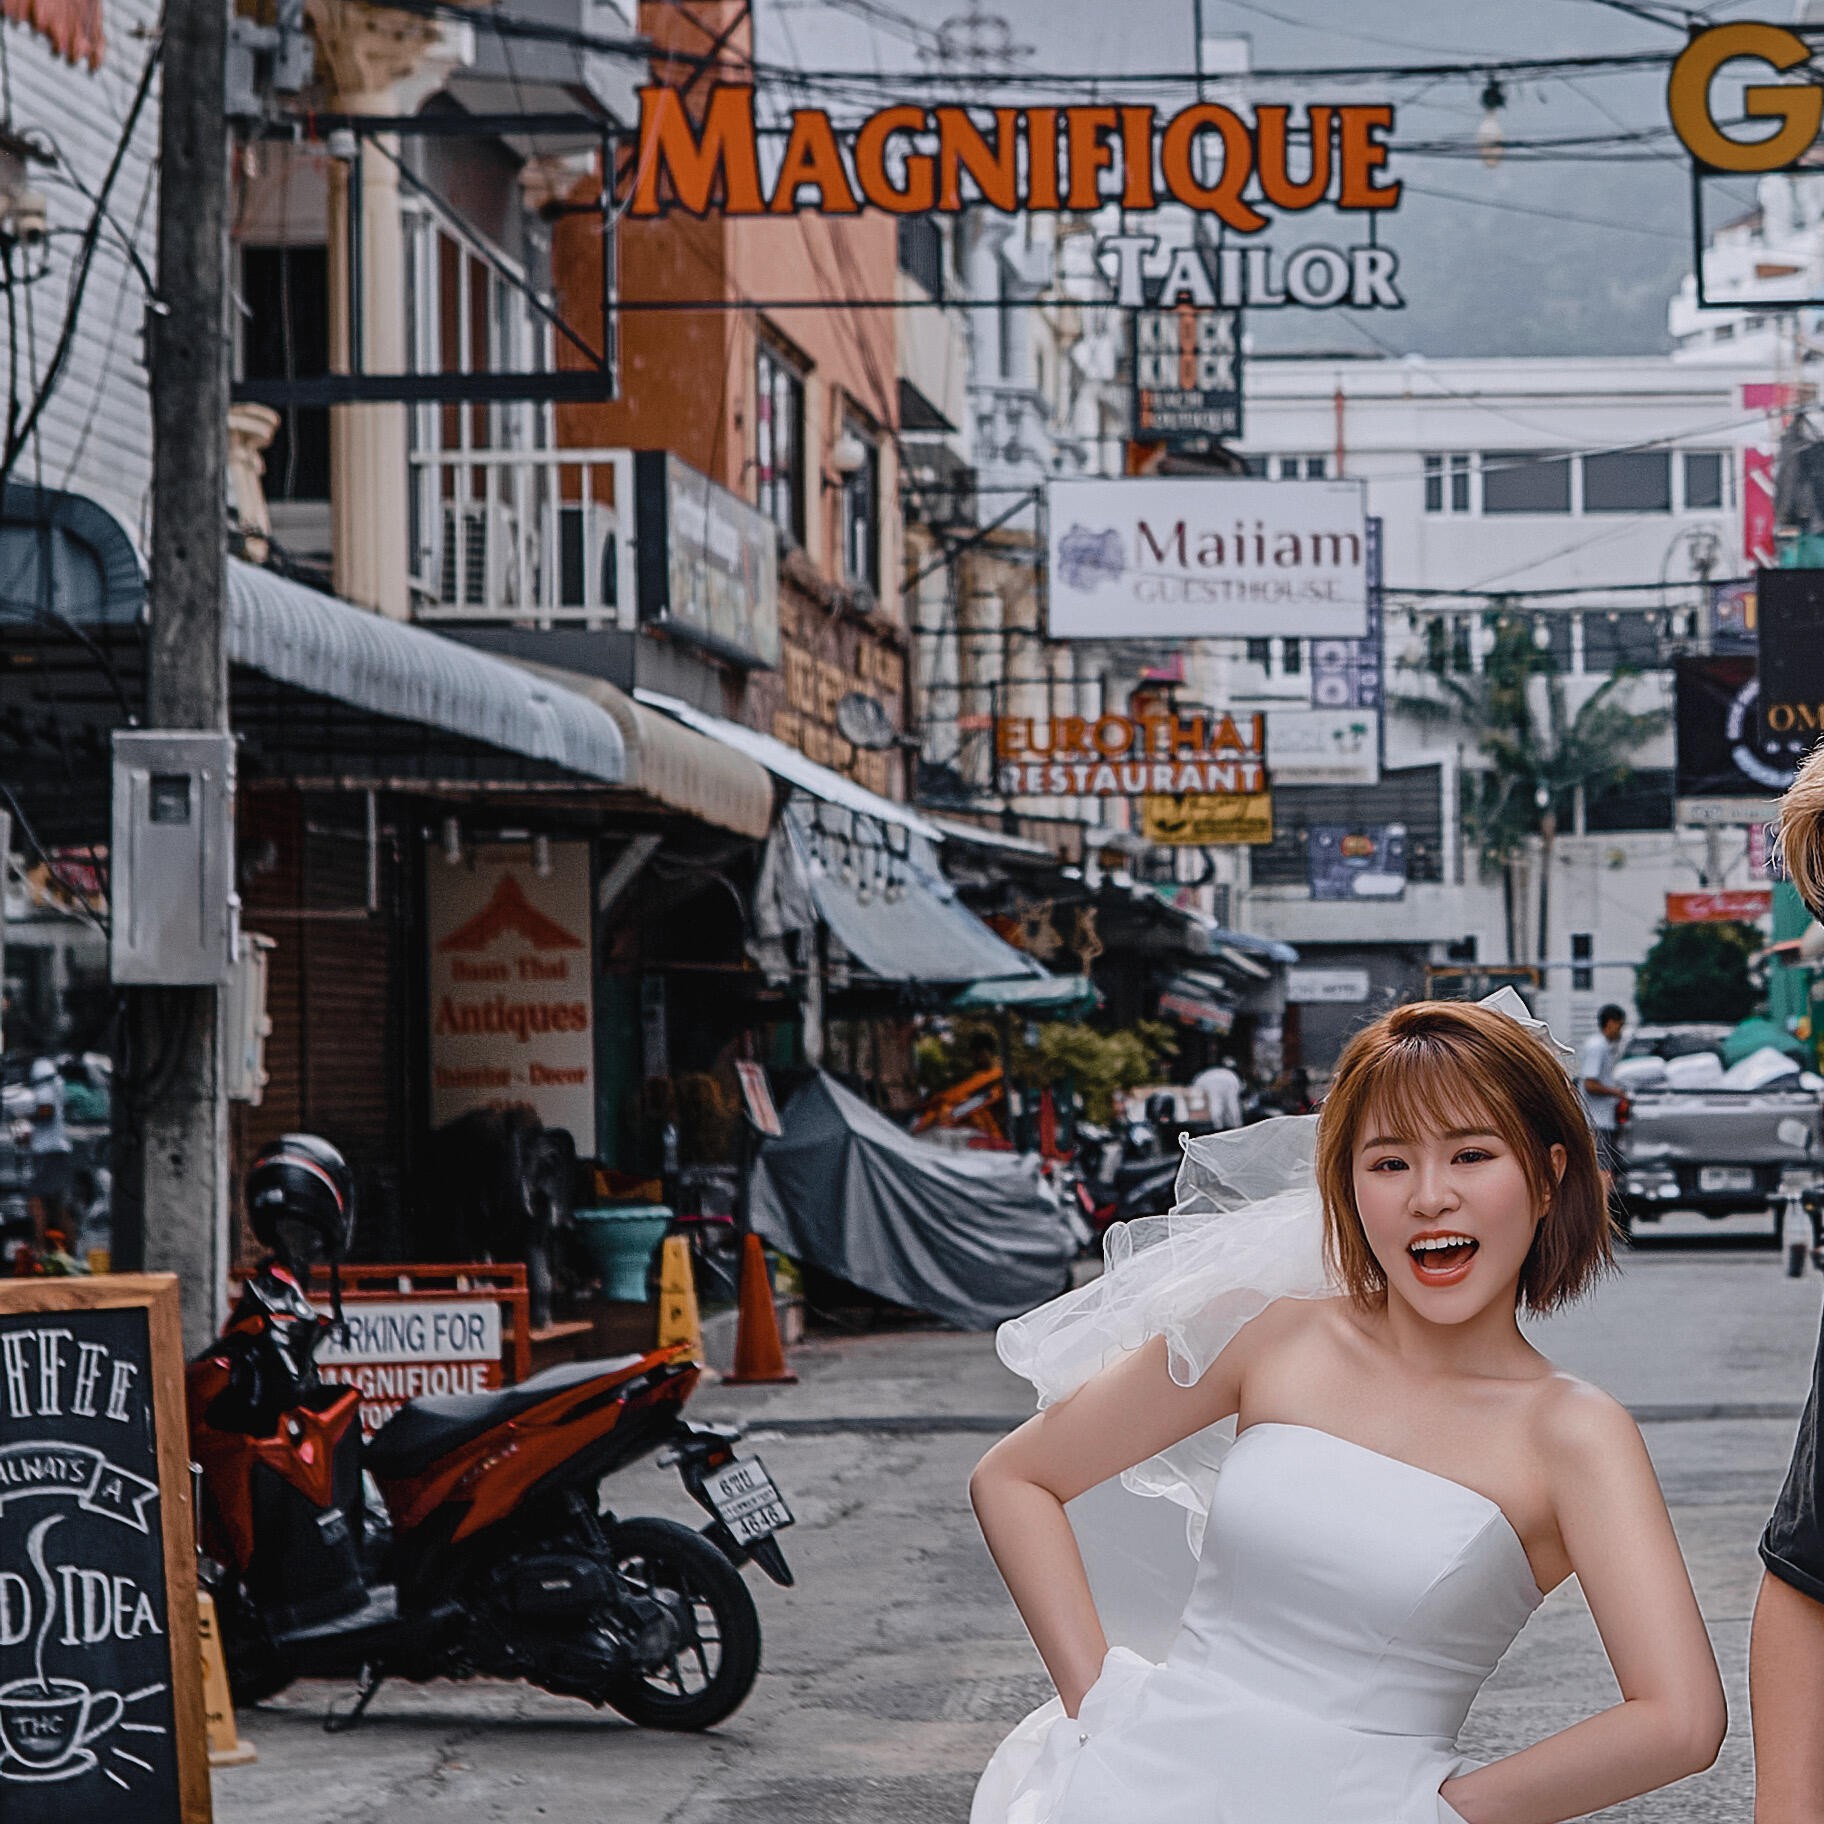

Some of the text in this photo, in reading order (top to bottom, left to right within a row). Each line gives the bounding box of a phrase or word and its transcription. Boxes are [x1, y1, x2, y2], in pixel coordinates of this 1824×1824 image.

[629, 82, 1403, 232] MAGNIFIQUE
[1101, 234, 1405, 308] TAILOR
[1134, 520, 1361, 568] Maiiam
[1134, 578, 1343, 602] GUESTHOUSE
[1003, 762, 1264, 794] RESTAURANT
[435, 996, 588, 1044] Antiques
[433, 1313, 486, 1350] FOR
[56, 1564, 164, 1647] IDEA
[11, 1714, 64, 1734] THC
